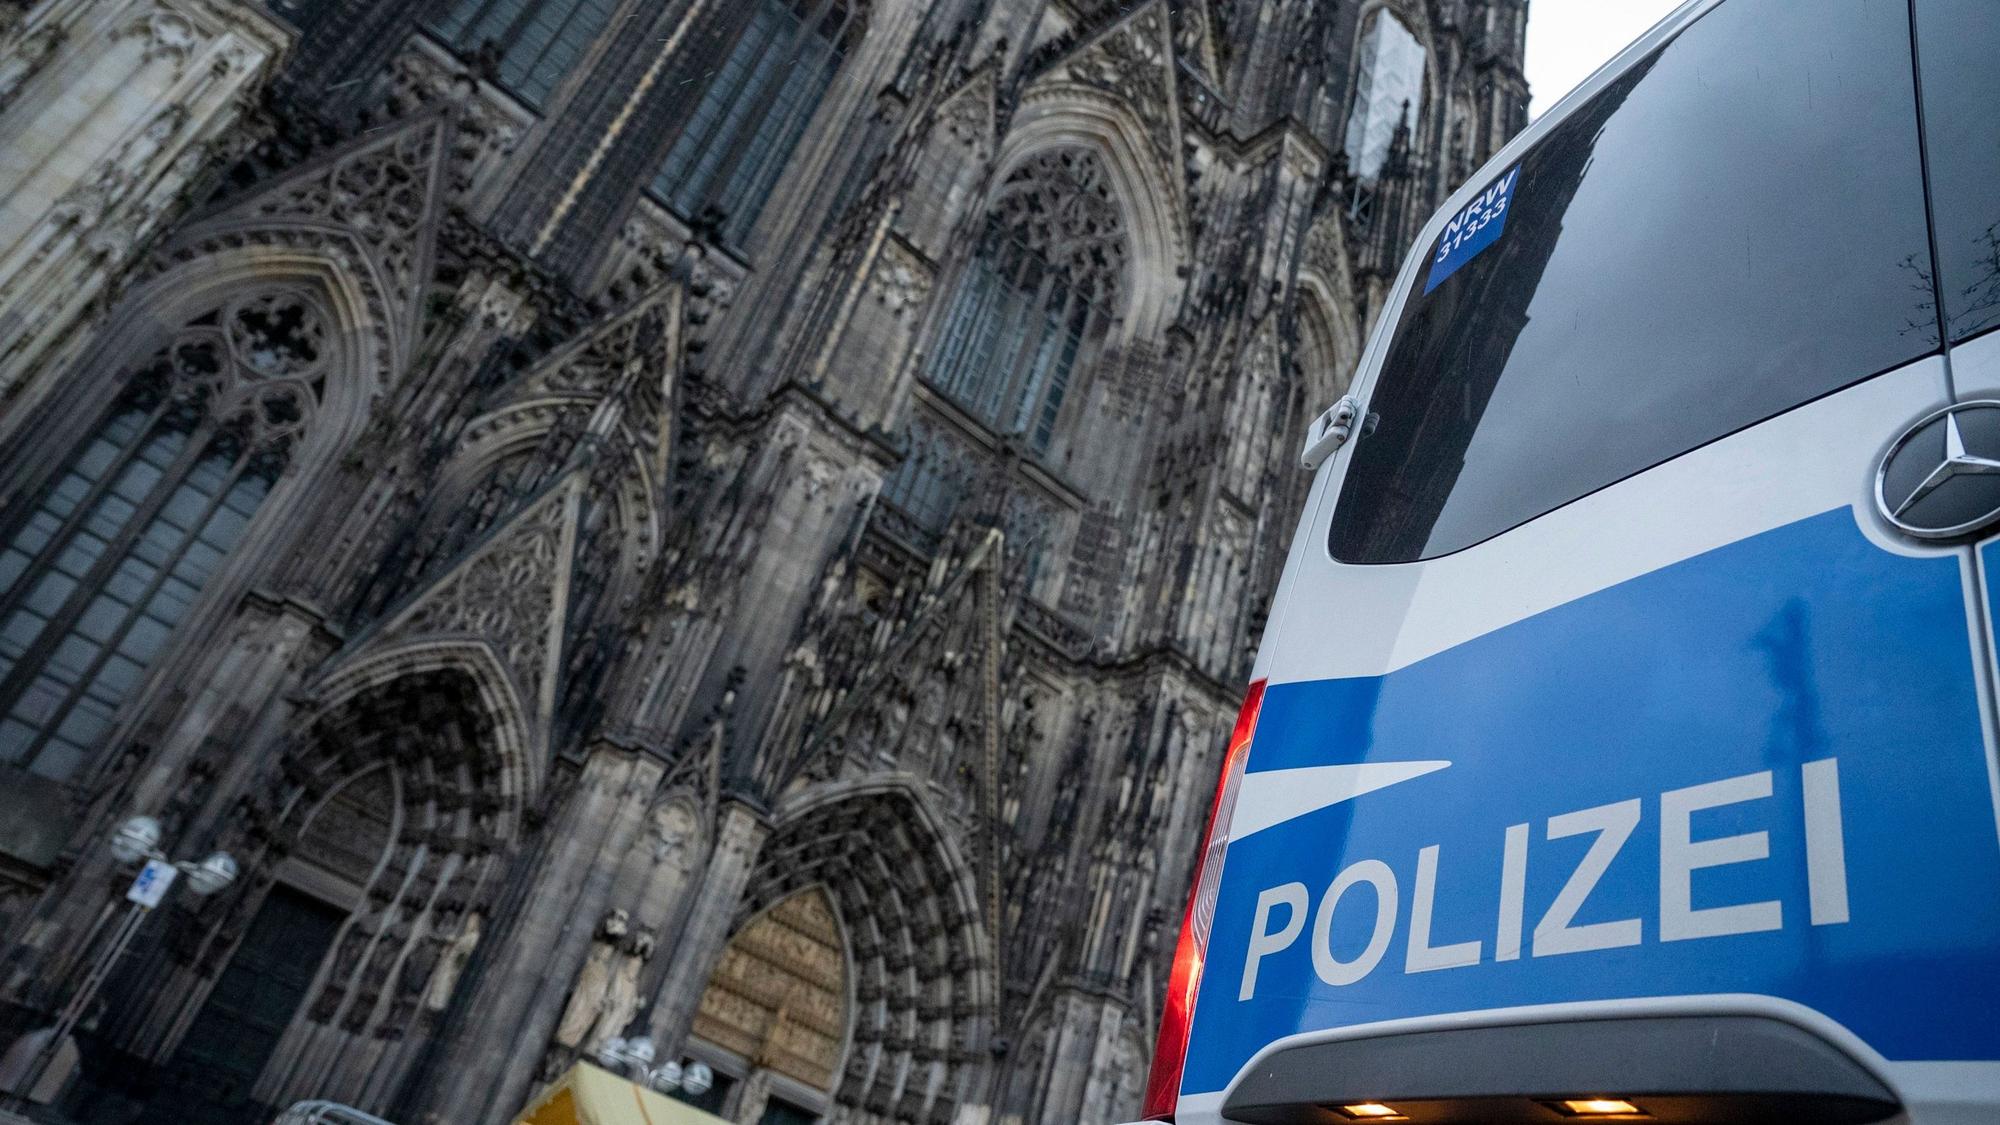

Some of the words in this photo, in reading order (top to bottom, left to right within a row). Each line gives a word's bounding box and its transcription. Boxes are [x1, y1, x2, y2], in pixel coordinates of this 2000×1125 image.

[1437, 197, 1507, 263] 31333
[1443, 169, 1516, 242] NRW
[1238, 757, 1850, 1002] POLIZEI
